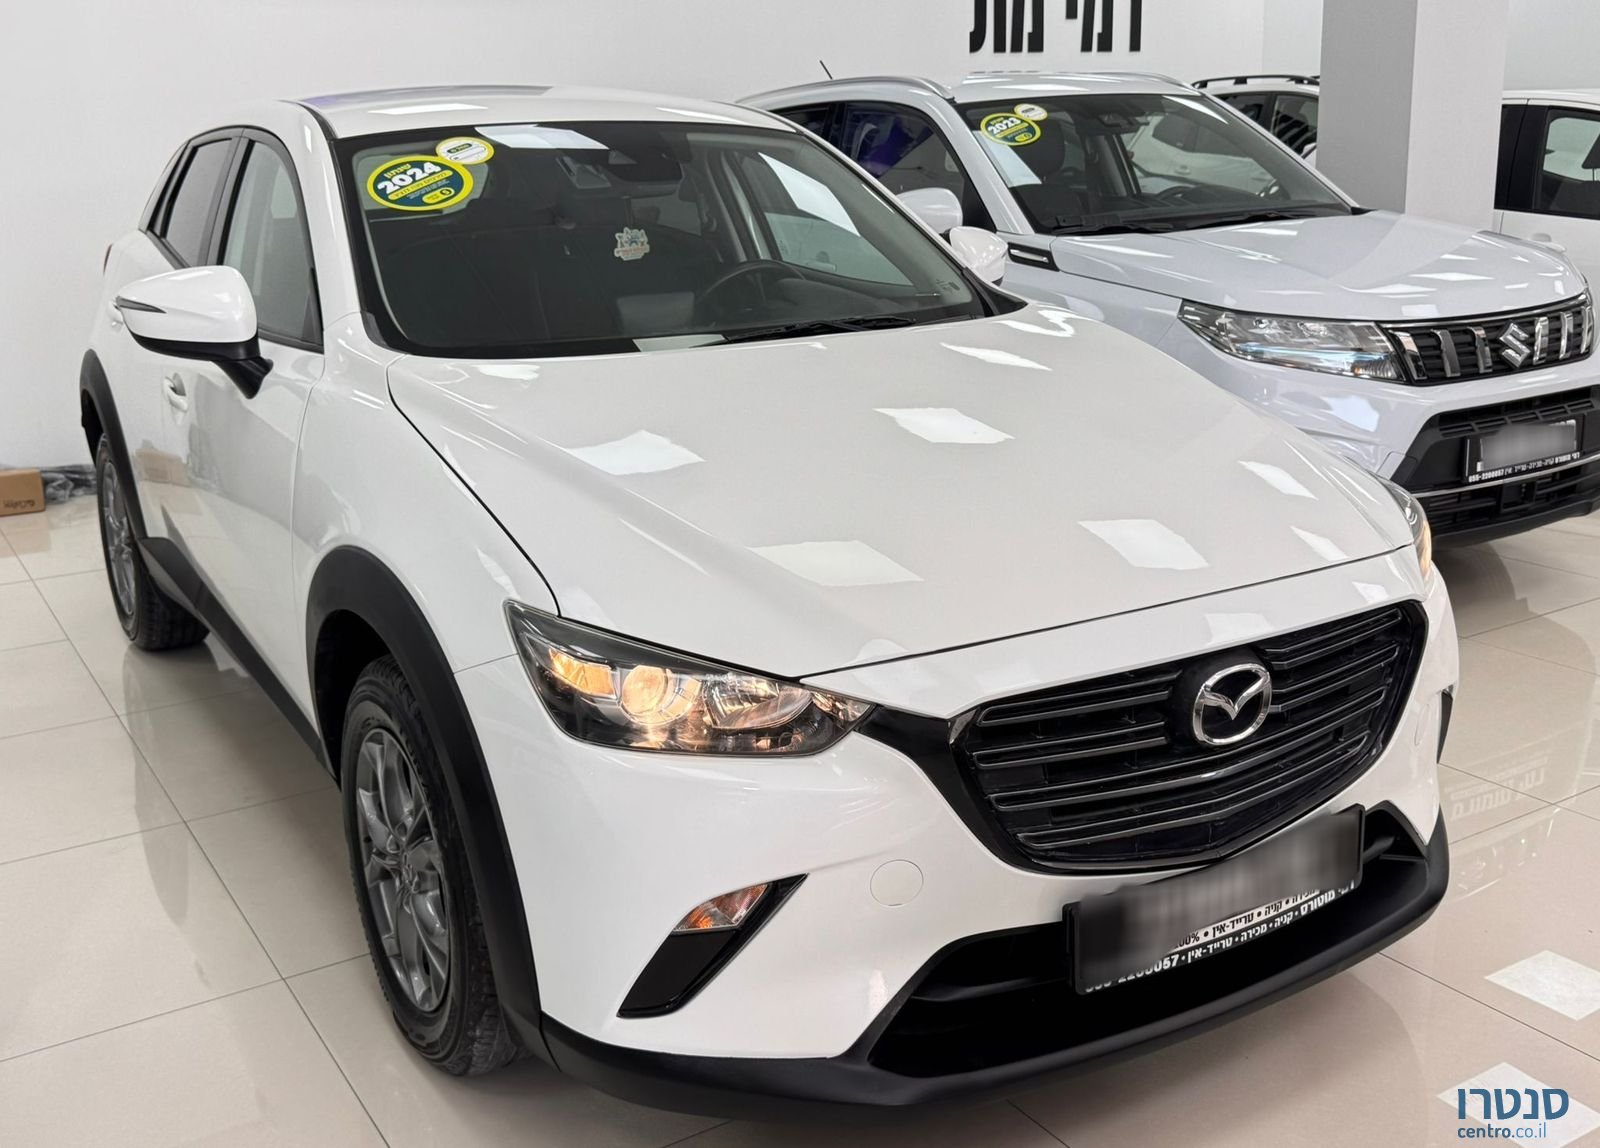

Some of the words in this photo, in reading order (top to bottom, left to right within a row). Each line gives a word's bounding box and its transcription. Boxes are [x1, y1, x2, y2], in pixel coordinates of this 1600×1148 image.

[377, 162, 442, 194] 2024
[1265, 901, 1283, 917] קניה
[1300, 889, 1336, 916] מוטורס
[1274, 911, 1294, 928] קניה
[1175, 931, 1200, 948] 00%
[1240, 922, 1267, 943] מכירה
[1187, 936, 1233, 963] טרייד-אין
